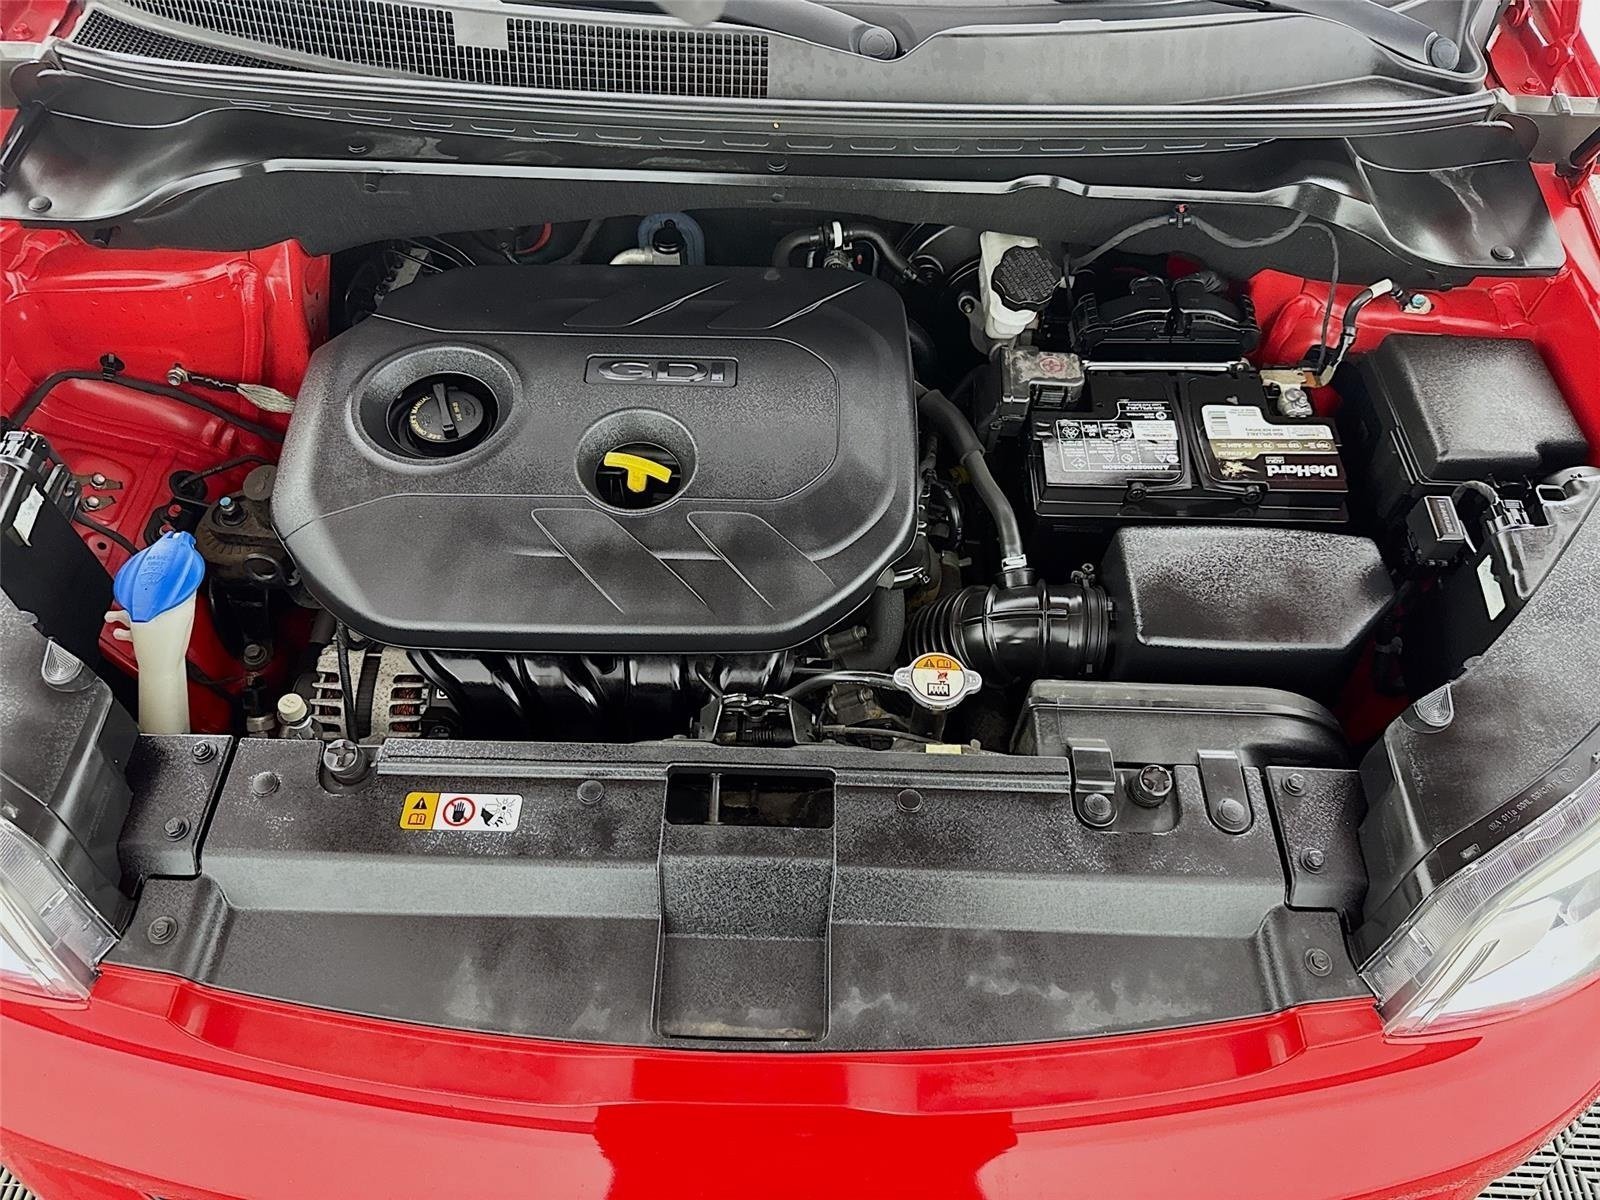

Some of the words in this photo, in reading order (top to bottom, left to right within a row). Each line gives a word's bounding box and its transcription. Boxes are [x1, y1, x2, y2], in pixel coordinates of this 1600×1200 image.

[597, 361, 725, 383] GDI
[411, 395, 432, 414] MANUAL
[409, 414, 427, 436] OWNER'S
[1266, 464, 1338, 477] DieHard
